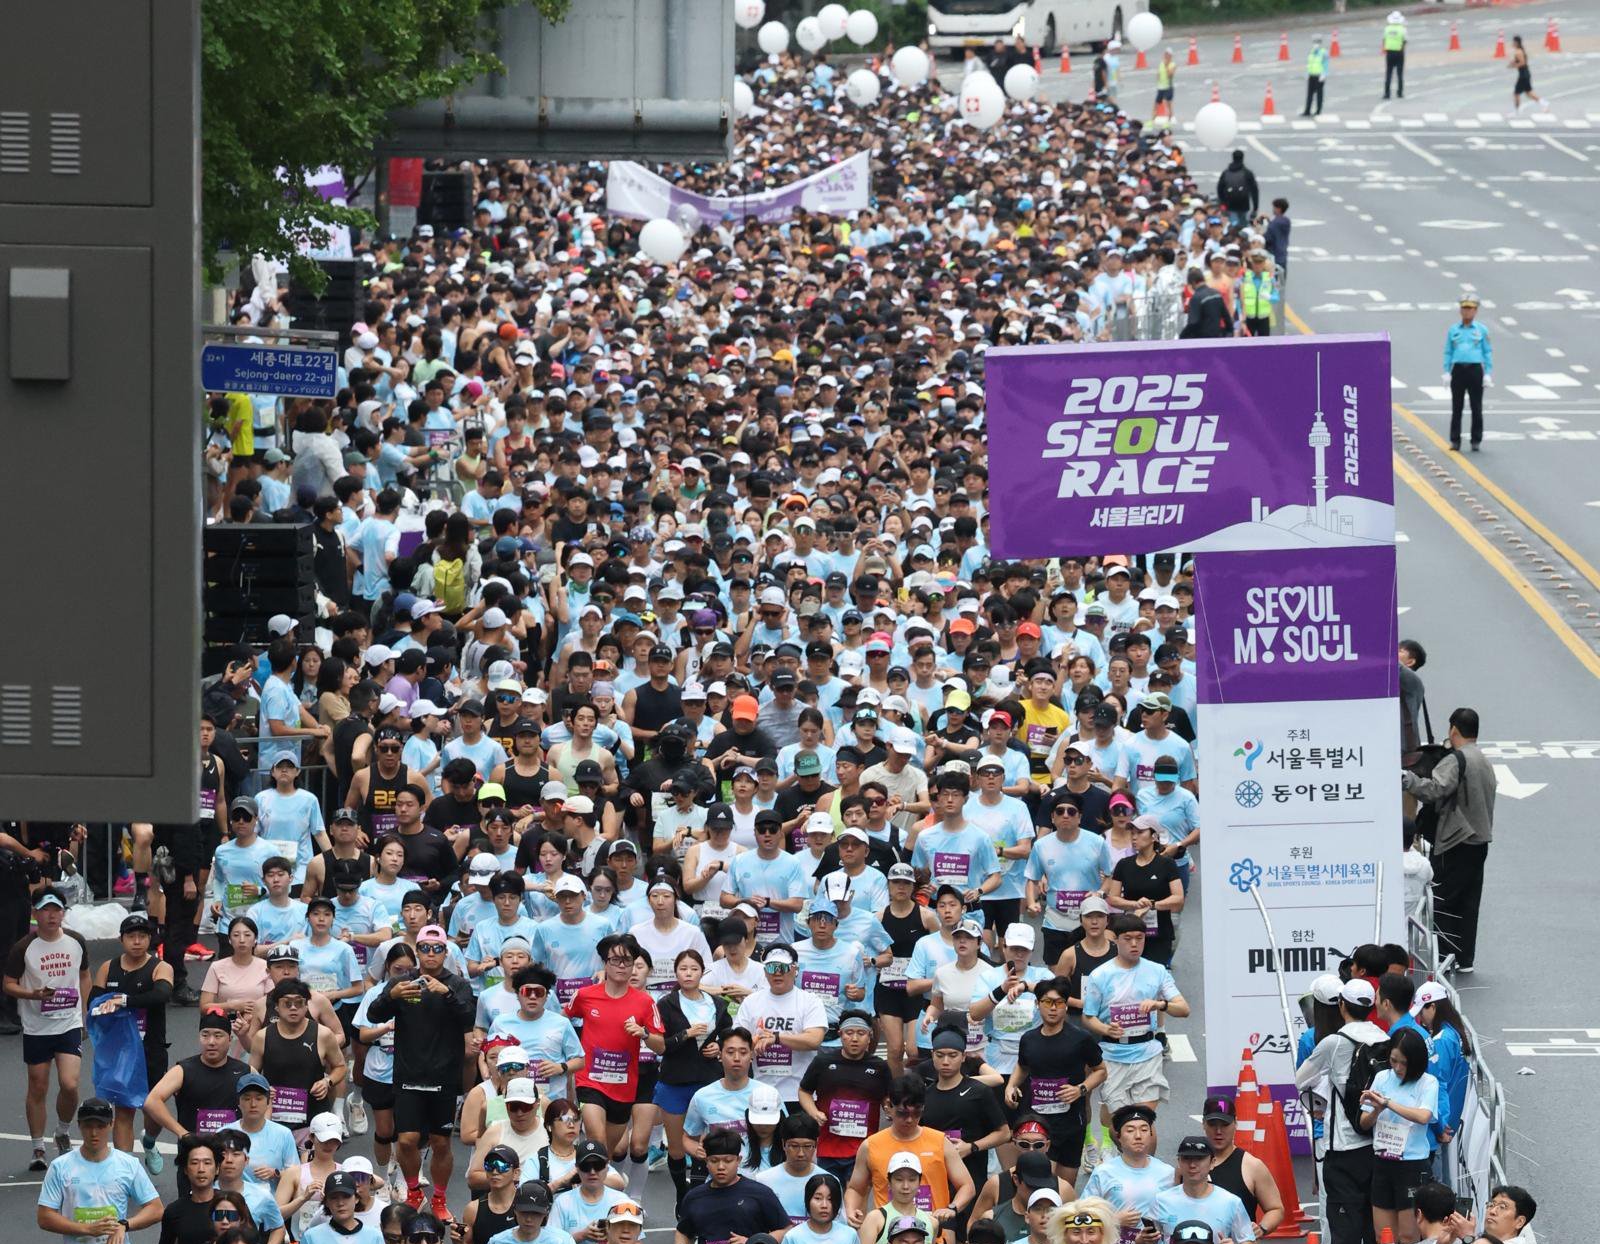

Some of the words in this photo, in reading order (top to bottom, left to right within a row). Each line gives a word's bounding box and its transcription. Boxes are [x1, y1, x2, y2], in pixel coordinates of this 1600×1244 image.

[250, 351, 334, 371] 세종대로22길
[234, 368, 302, 382] Sejong-daero
[304, 372, 333, 384] 22-gil
[1063, 373, 1208, 415] 2025
[1042, 415, 1230, 458] SEOUL
[1343, 385, 1359, 486] 2025.10.12
[1057, 456, 1216, 498] RACE
[1089, 504, 1185, 528] 서울달리기
[1287, 729, 1311, 742] 주최
[1266, 746, 1364, 770] 서울특별시
[1271, 783, 1365, 803] 동아일보
[1290, 846, 1313, 859] 후원
[1266, 862, 1376, 881] 서울특별시체육회
[1291, 930, 1315, 943] 협찬
[40, 952, 71, 964] BROOKS
[1248, 947, 1326, 973] PUMA
[47, 970, 66, 978] CLUB
